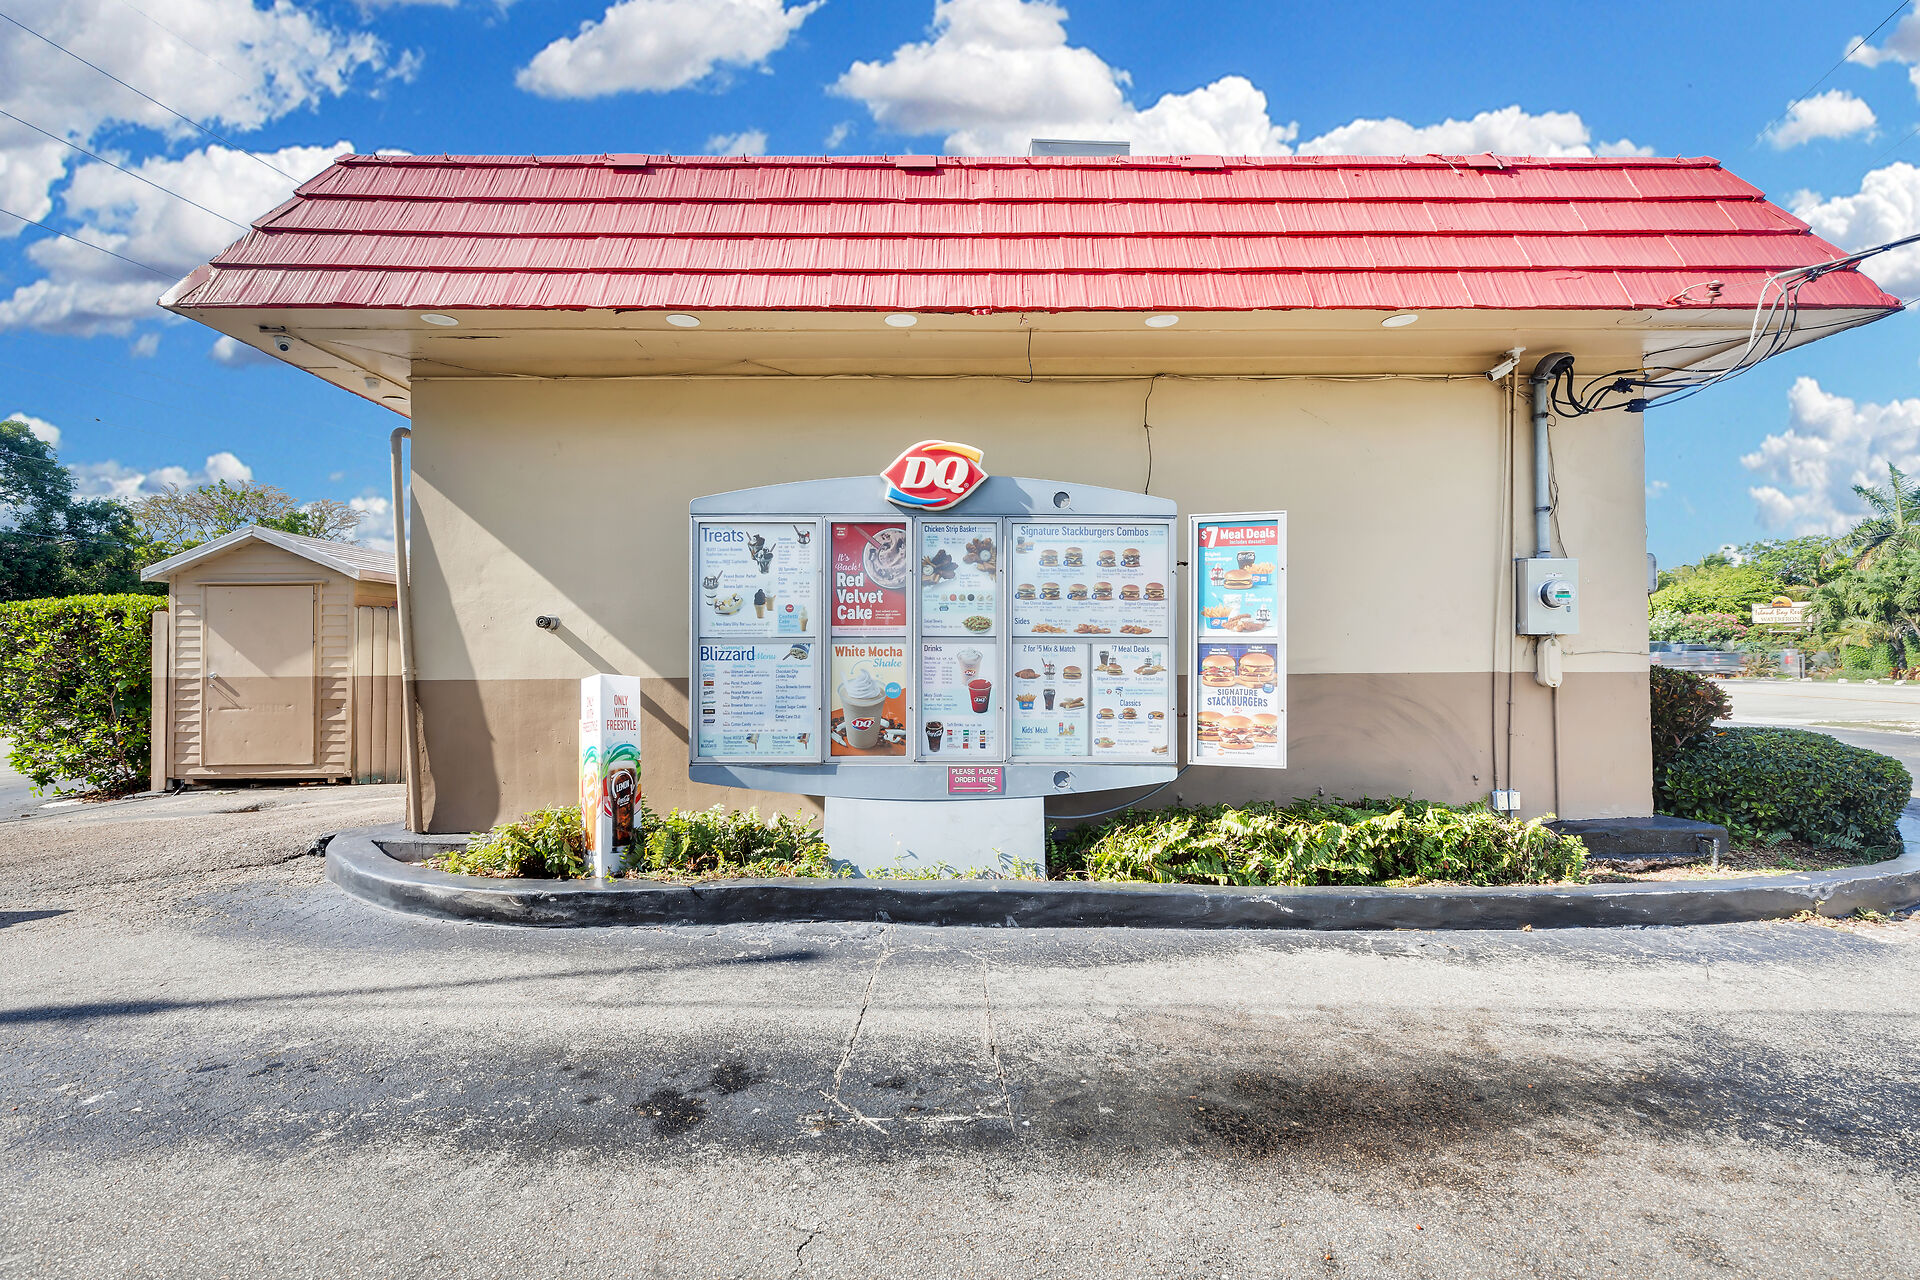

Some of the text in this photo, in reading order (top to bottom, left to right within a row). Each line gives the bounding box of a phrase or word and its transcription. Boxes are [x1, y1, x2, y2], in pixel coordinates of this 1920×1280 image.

[900, 456, 969, 493] DQ
[701, 528, 744, 542] Treats
[924, 525, 945, 533] Chicken
[946, 525, 959, 534] Strip
[960, 525, 977, 533] Basket
[1020, 525, 1060, 538] Signature
[1062, 526, 1115, 538] Stackburgers
[1116, 526, 1149, 537] Combos
[1201, 526, 1276, 549] $7 Meal Deals
[838, 553, 850, 562] It's
[835, 563, 861, 571] Back!
[836, 572, 864, 587] Red
[836, 589, 884, 604] Velvet
[837, 605, 873, 620] Cake
[1755, 608, 1774, 616] Island
[1776, 608, 1788, 616] Bay
[1014, 617, 1030, 625] Sides
[700, 645, 776, 661] Blizzard Menu
[835, 645, 903, 657] White Mocha
[923, 644, 942, 652] Drinks
[872, 658, 902, 668] Shake
[1217, 688, 1258, 697] SIGNATURE
[613, 694, 629, 706] ONLY
[1120, 699, 1141, 707] Classics
[1207, 695, 1268, 707] STACKBURGERS
[613, 707, 629, 719] WITH
[606, 719, 637, 731] FREESTYLE
[616, 780, 630, 793] LEMON
